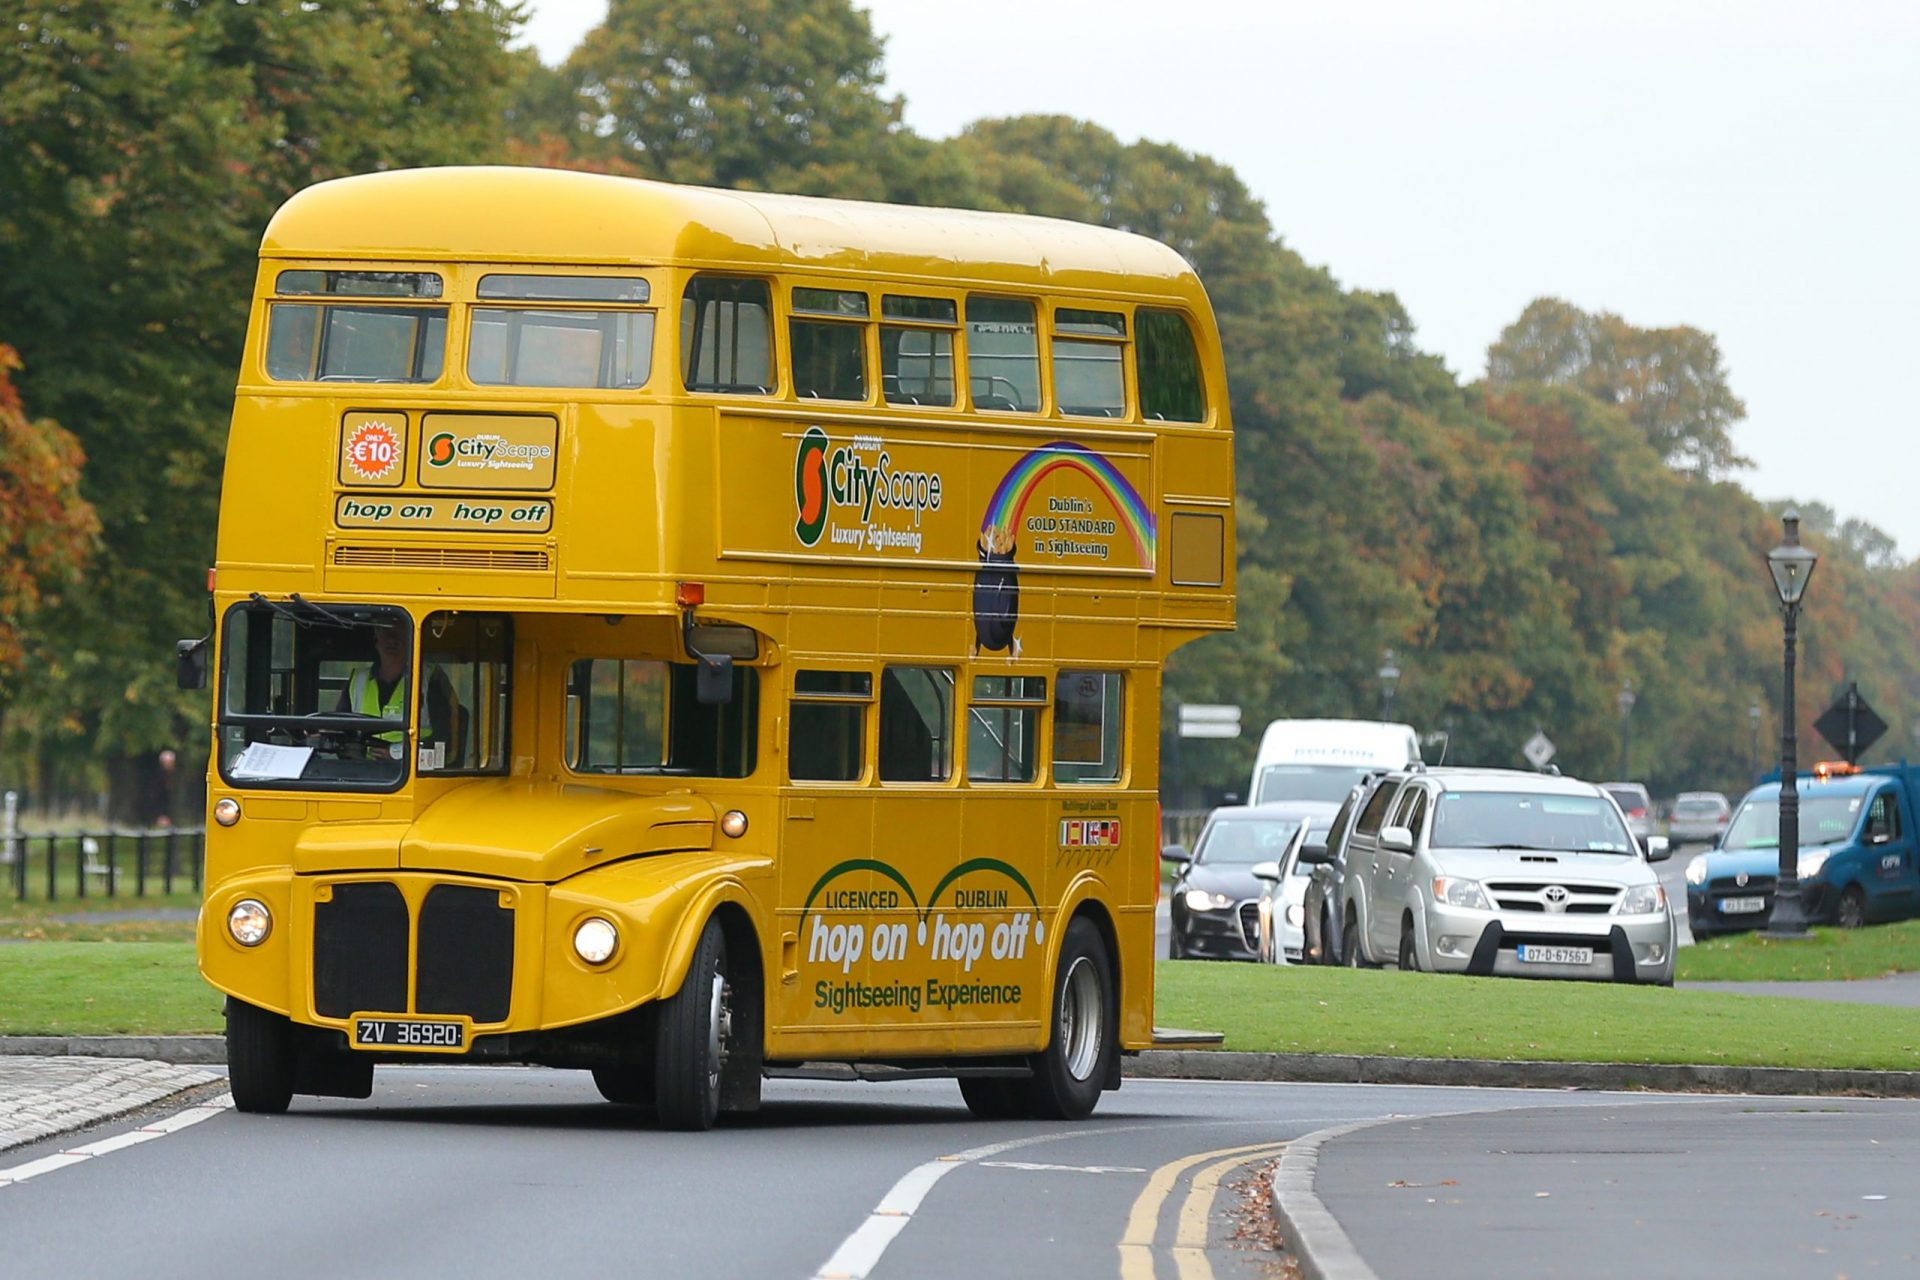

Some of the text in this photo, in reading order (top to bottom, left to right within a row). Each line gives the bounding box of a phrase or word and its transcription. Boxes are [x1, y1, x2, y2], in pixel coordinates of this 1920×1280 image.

[364, 433, 384, 443] ONLY
[353, 441, 392, 462] €10
[457, 438, 550, 461] CityScape
[457, 460, 534, 470] Luxury Sightseeing
[830, 445, 942, 528] CityScape
[343, 502, 546, 524] hop on hop off
[1048, 497, 1093, 514] Dublin's
[1027, 517, 1116, 535] GOLD STANDARD
[831, 522, 922, 554] Luxury Sightseeing
[1034, 537, 1108, 560] in Sightseeing
[826, 889, 1008, 910] LICENCED DUBLIN
[808, 912, 1031, 974] hop on hop off
[1528, 948, 1588, 962] 07-D-67563
[815, 977, 1021, 1014] Sightseeing Experience
[361, 1022, 457, 1045] ZV 36920
